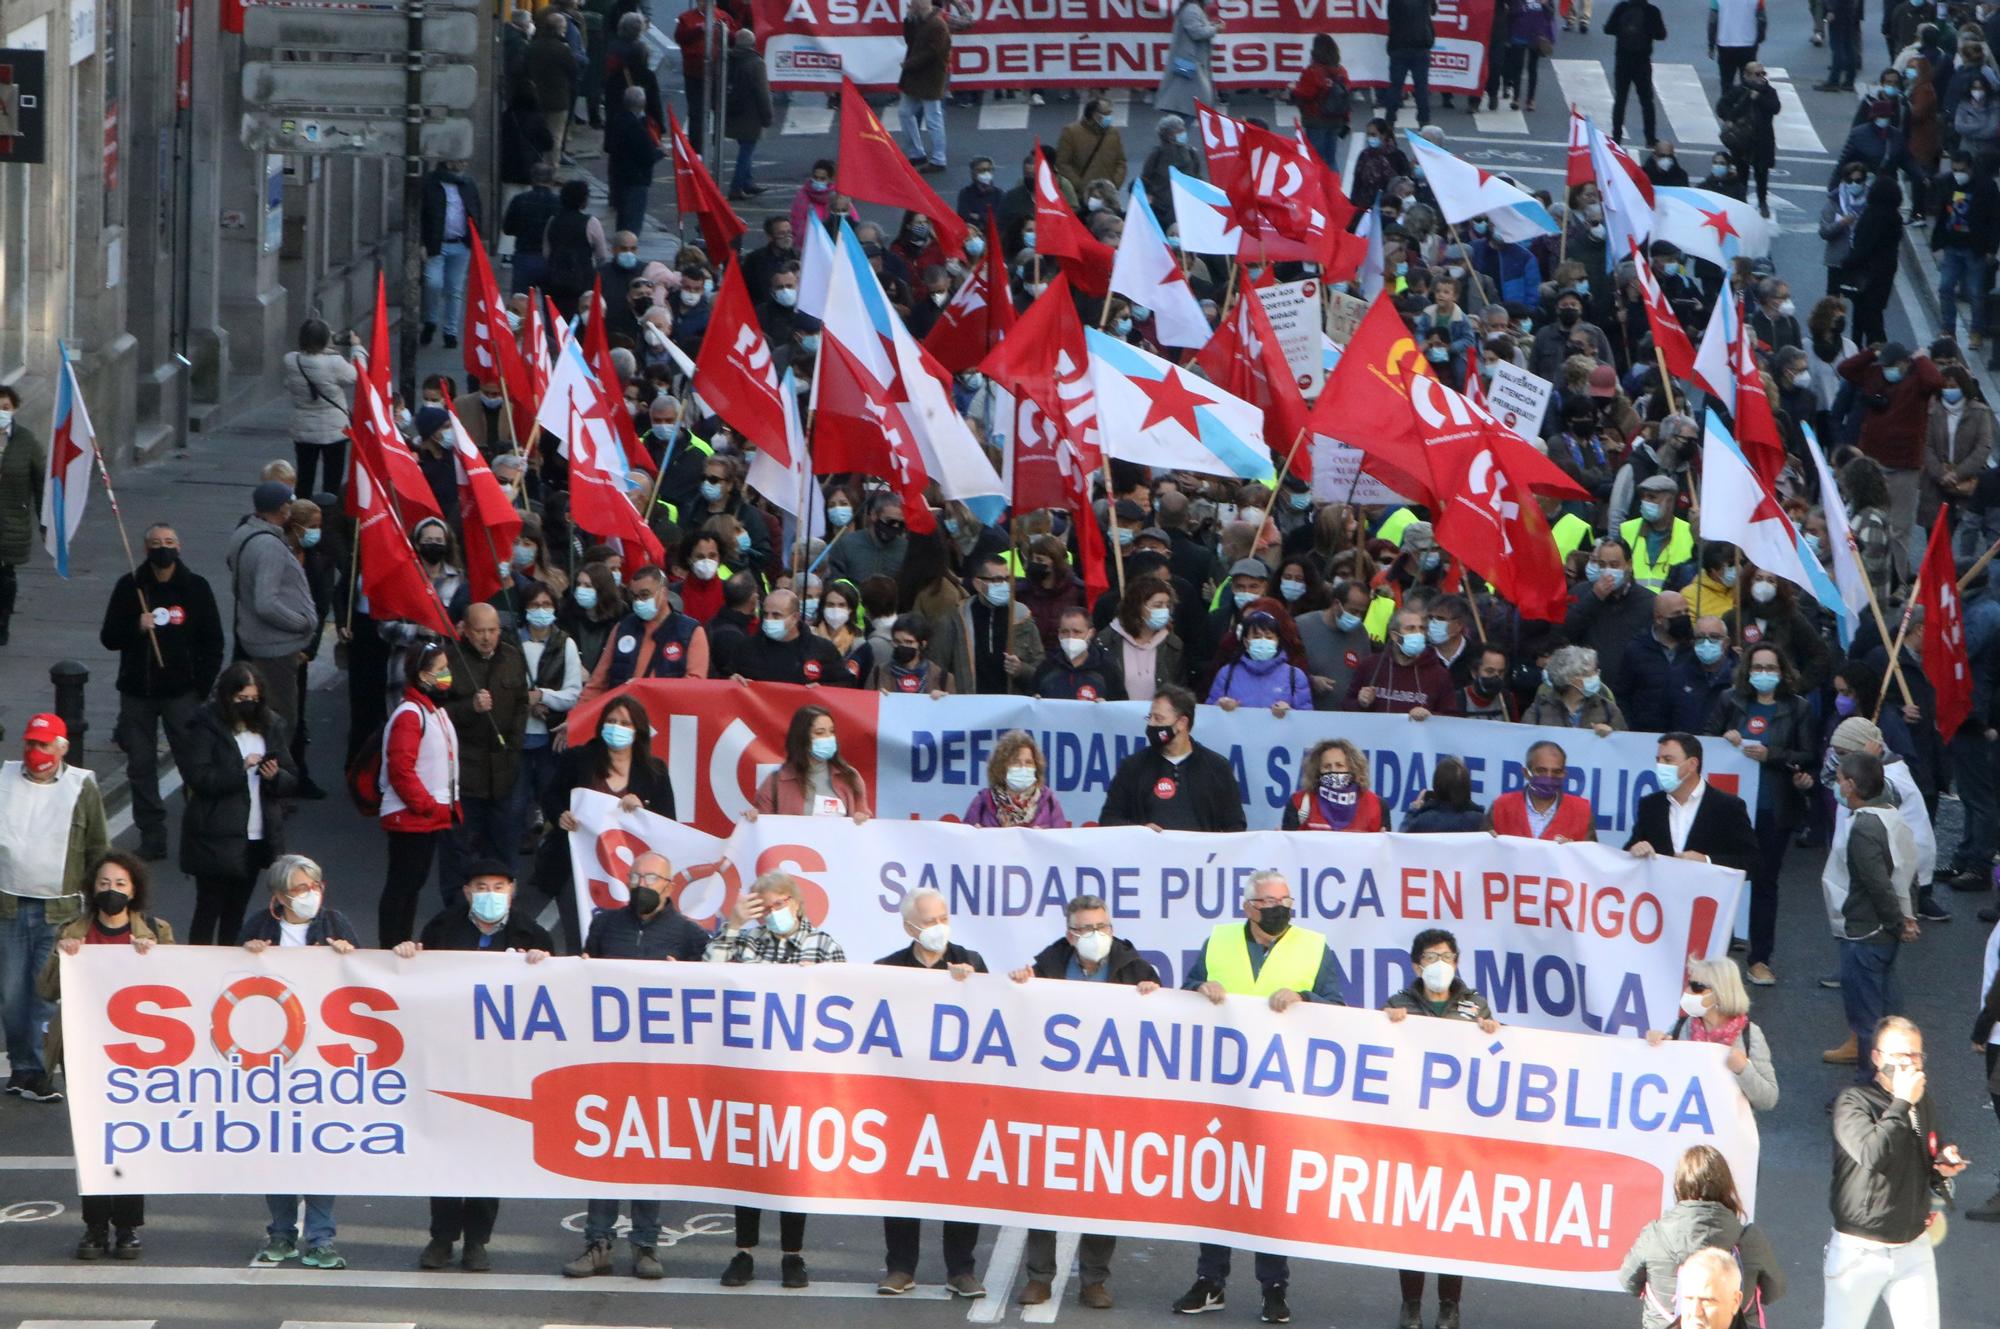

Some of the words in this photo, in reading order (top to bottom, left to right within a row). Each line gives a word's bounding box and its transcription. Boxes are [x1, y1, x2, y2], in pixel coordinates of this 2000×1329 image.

[784, 0, 819, 24] A
[827, 0, 1086, 24] SADADE
[1099, 0, 1182, 19] NO
[1218, 0, 1281, 19] SE
[1292, 0, 1469, 31] VENE,
[1160, 853, 1384, 919] PÚBICA
[1400, 867, 1464, 920] EN
[1482, 871, 1664, 944] PERIGO
[103, 975, 405, 1071] SOS
[474, 984, 567, 1042] NA
[592, 985, 903, 1058] DEFENSA
[929, 1003, 1018, 1067] DA
[1040, 1013, 1398, 1106] SANIDADE
[1419, 1040, 1716, 1135] PÚBLICA
[106, 1055, 407, 1105] sanidade
[104, 1110, 406, 1165] pública
[573, 1094, 888, 1175] SALVEMOS
[905, 1113, 950, 1179] A
[966, 1117, 1266, 1210] ATENCIÓN
[1285, 1149, 1614, 1248] PRIMARIA!
